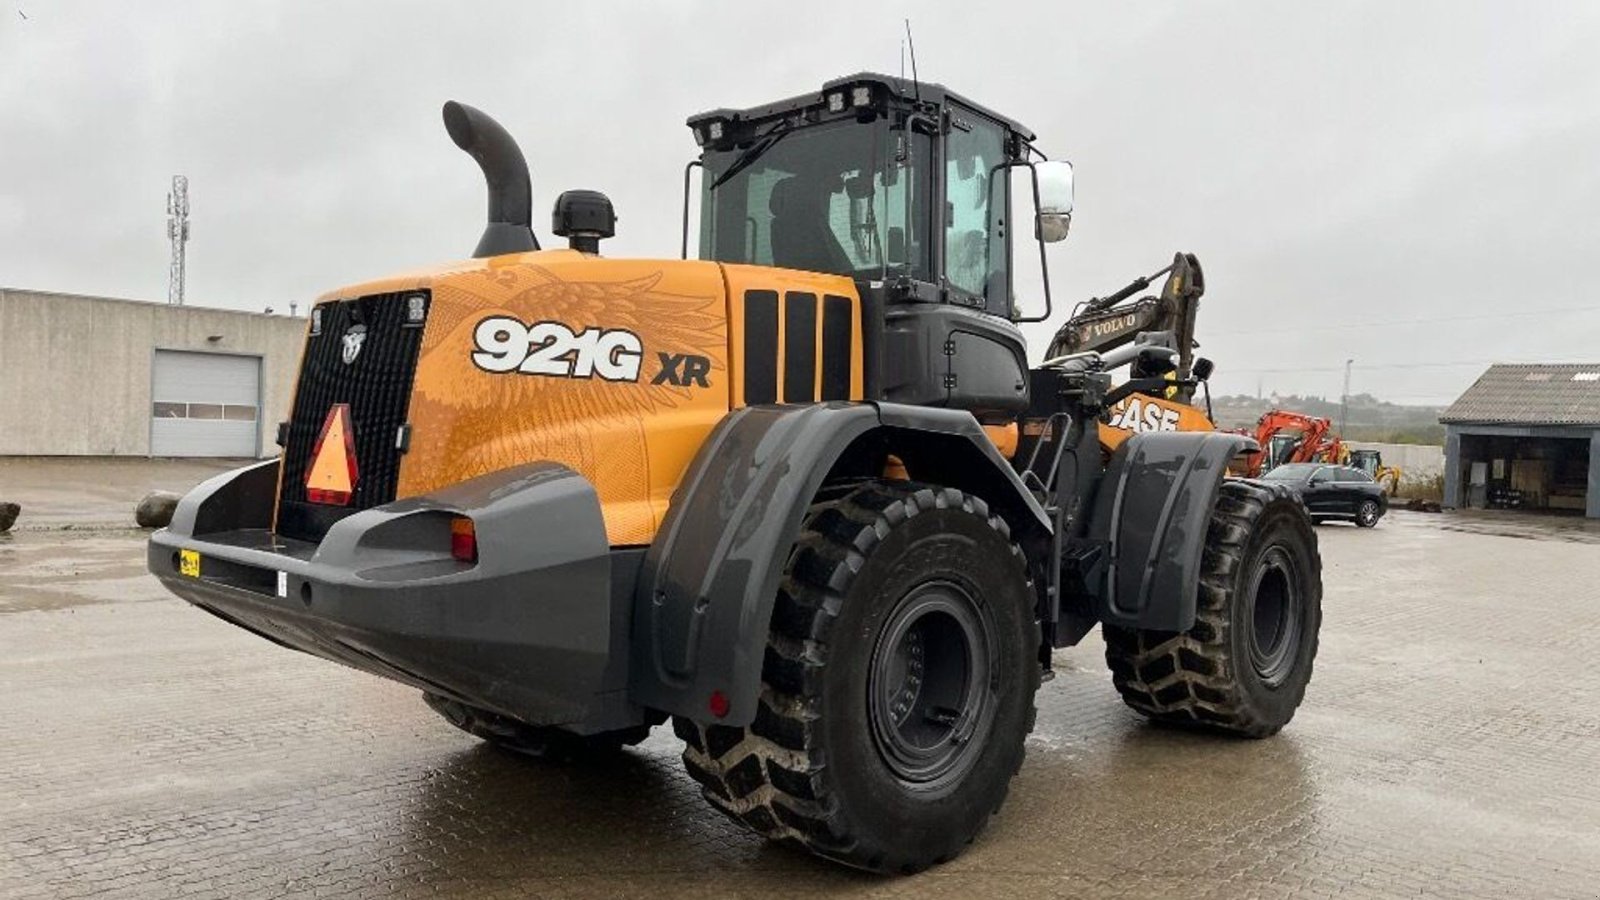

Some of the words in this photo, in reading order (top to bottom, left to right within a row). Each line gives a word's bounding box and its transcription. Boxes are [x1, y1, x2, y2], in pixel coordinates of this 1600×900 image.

[1094, 314, 1136, 337] VOLVO
[472, 315, 643, 383] 921G
[651, 352, 712, 388] XR
